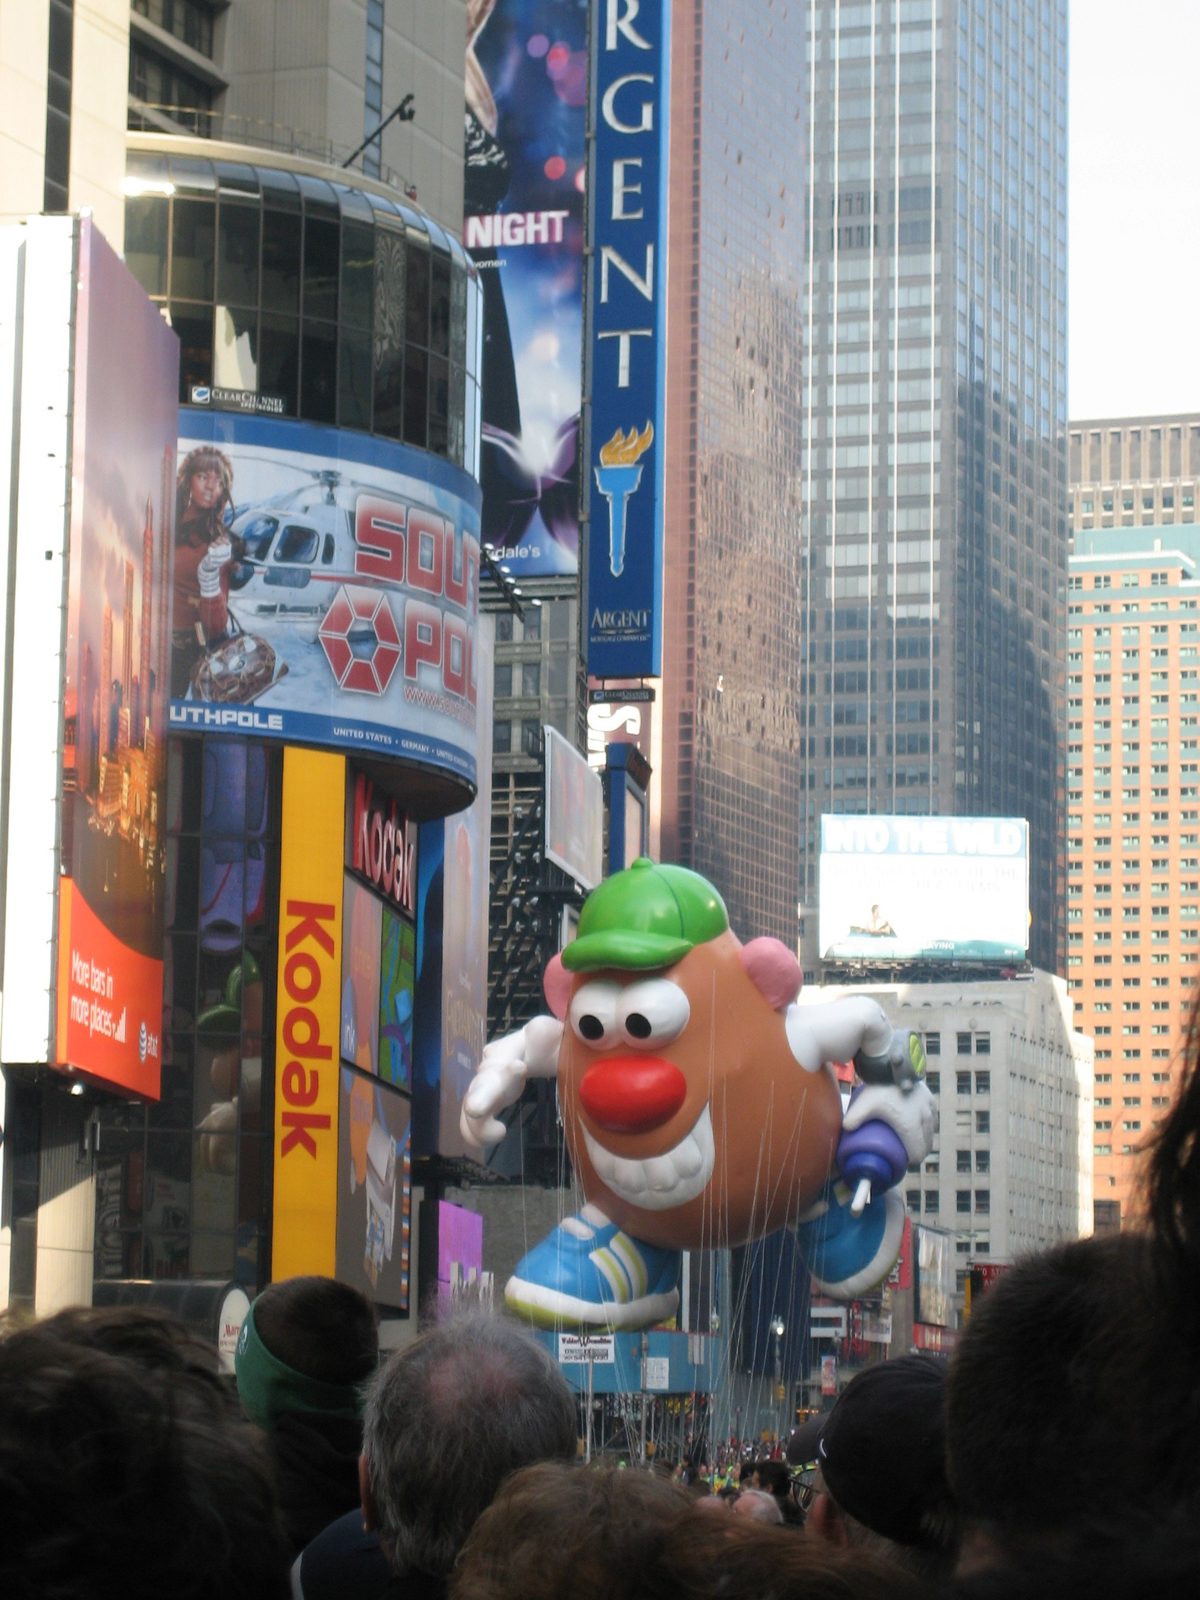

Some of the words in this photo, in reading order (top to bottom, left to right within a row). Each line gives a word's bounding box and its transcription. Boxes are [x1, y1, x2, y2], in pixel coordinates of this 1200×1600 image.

[466, 209, 570, 249] NIGHT
[169, 705, 283, 731] UTHPOLE
[333, 727, 364, 739] UNITED
[365, 731, 392, 745] STATES
[401, 739, 430, 753] GERMANY
[825, 819, 890, 854] INTO
[894, 820, 949, 855] THE
[953, 822, 1023, 856] WILD
[72, 949, 90, 988] More
[90, 958, 106, 996] bars
[106, 967, 114, 1000] in
[70, 995, 89, 1026] more
[89, 998, 112, 1038] places
[281, 900, 336, 1160] Kodak
